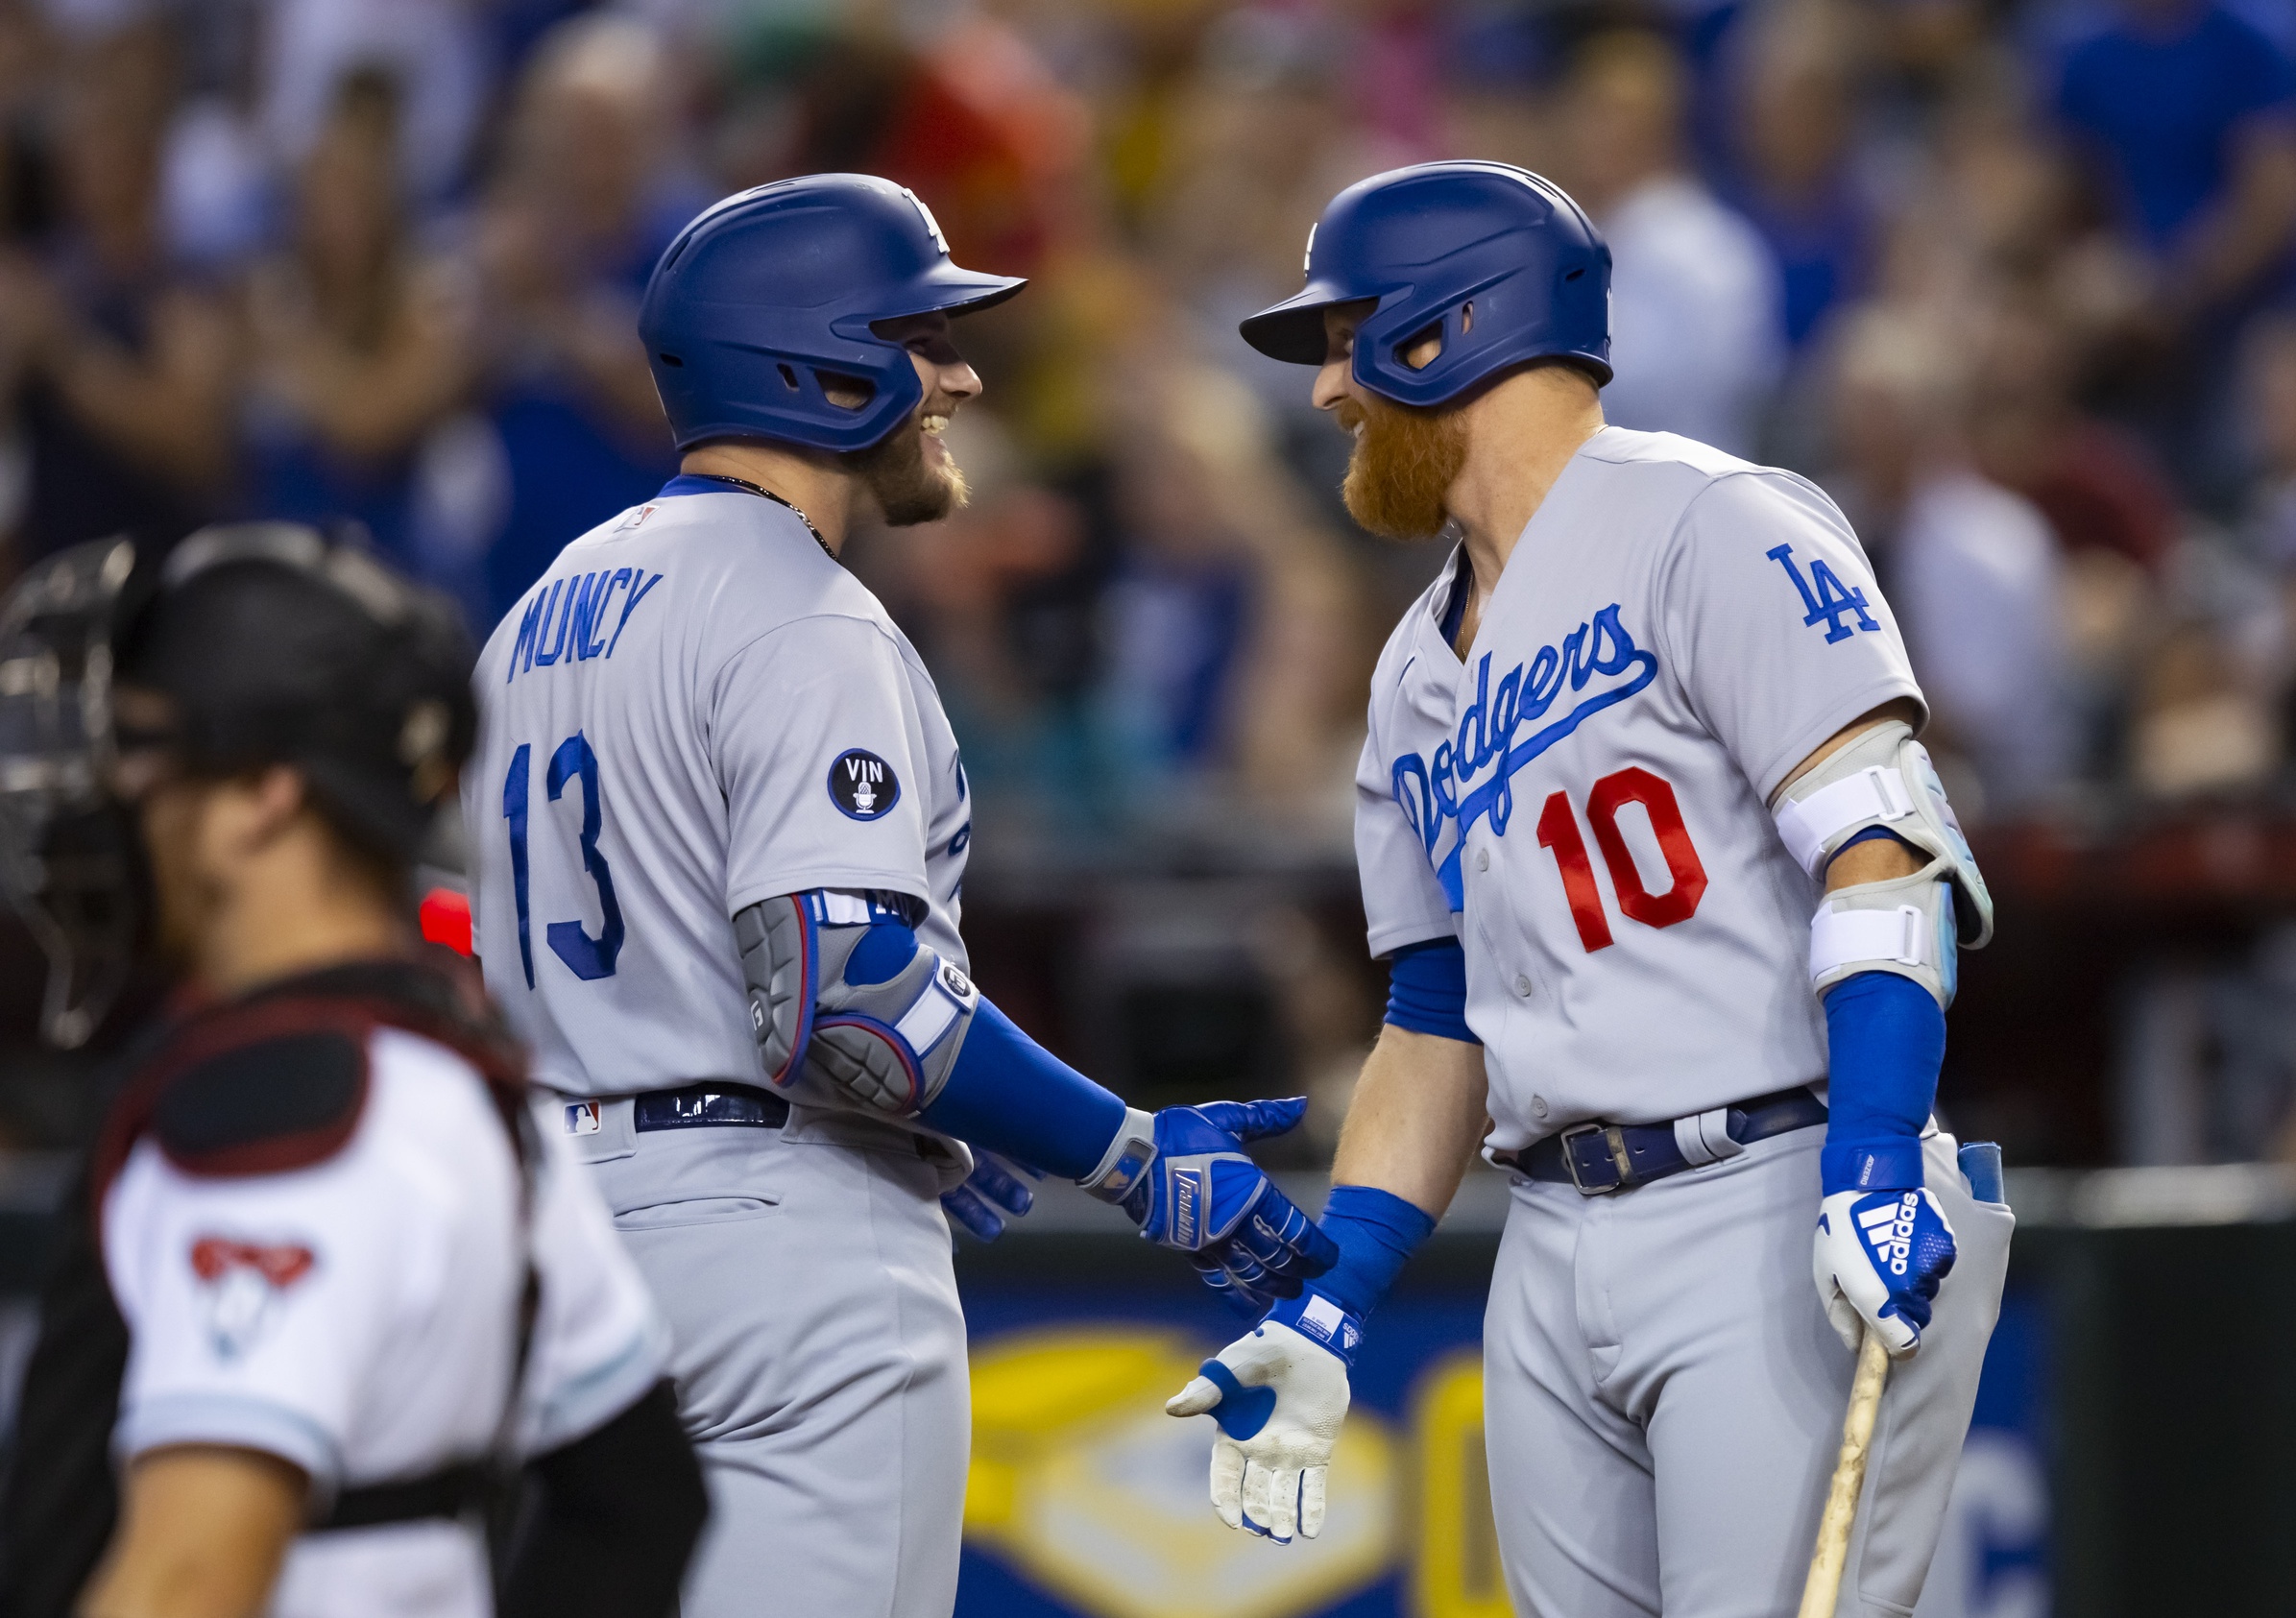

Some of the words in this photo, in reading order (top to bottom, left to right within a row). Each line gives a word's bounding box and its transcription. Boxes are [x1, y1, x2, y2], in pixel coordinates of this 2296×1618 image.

[506, 567, 665, 685] MUNCY
[1766, 543, 1880, 644] LA
[845, 758, 883, 783] VIN
[1392, 603, 1657, 864] Dodgers
[503, 728, 626, 991] 13
[1536, 766, 1708, 954] 10
[1890, 1192, 1919, 1275] adidas
